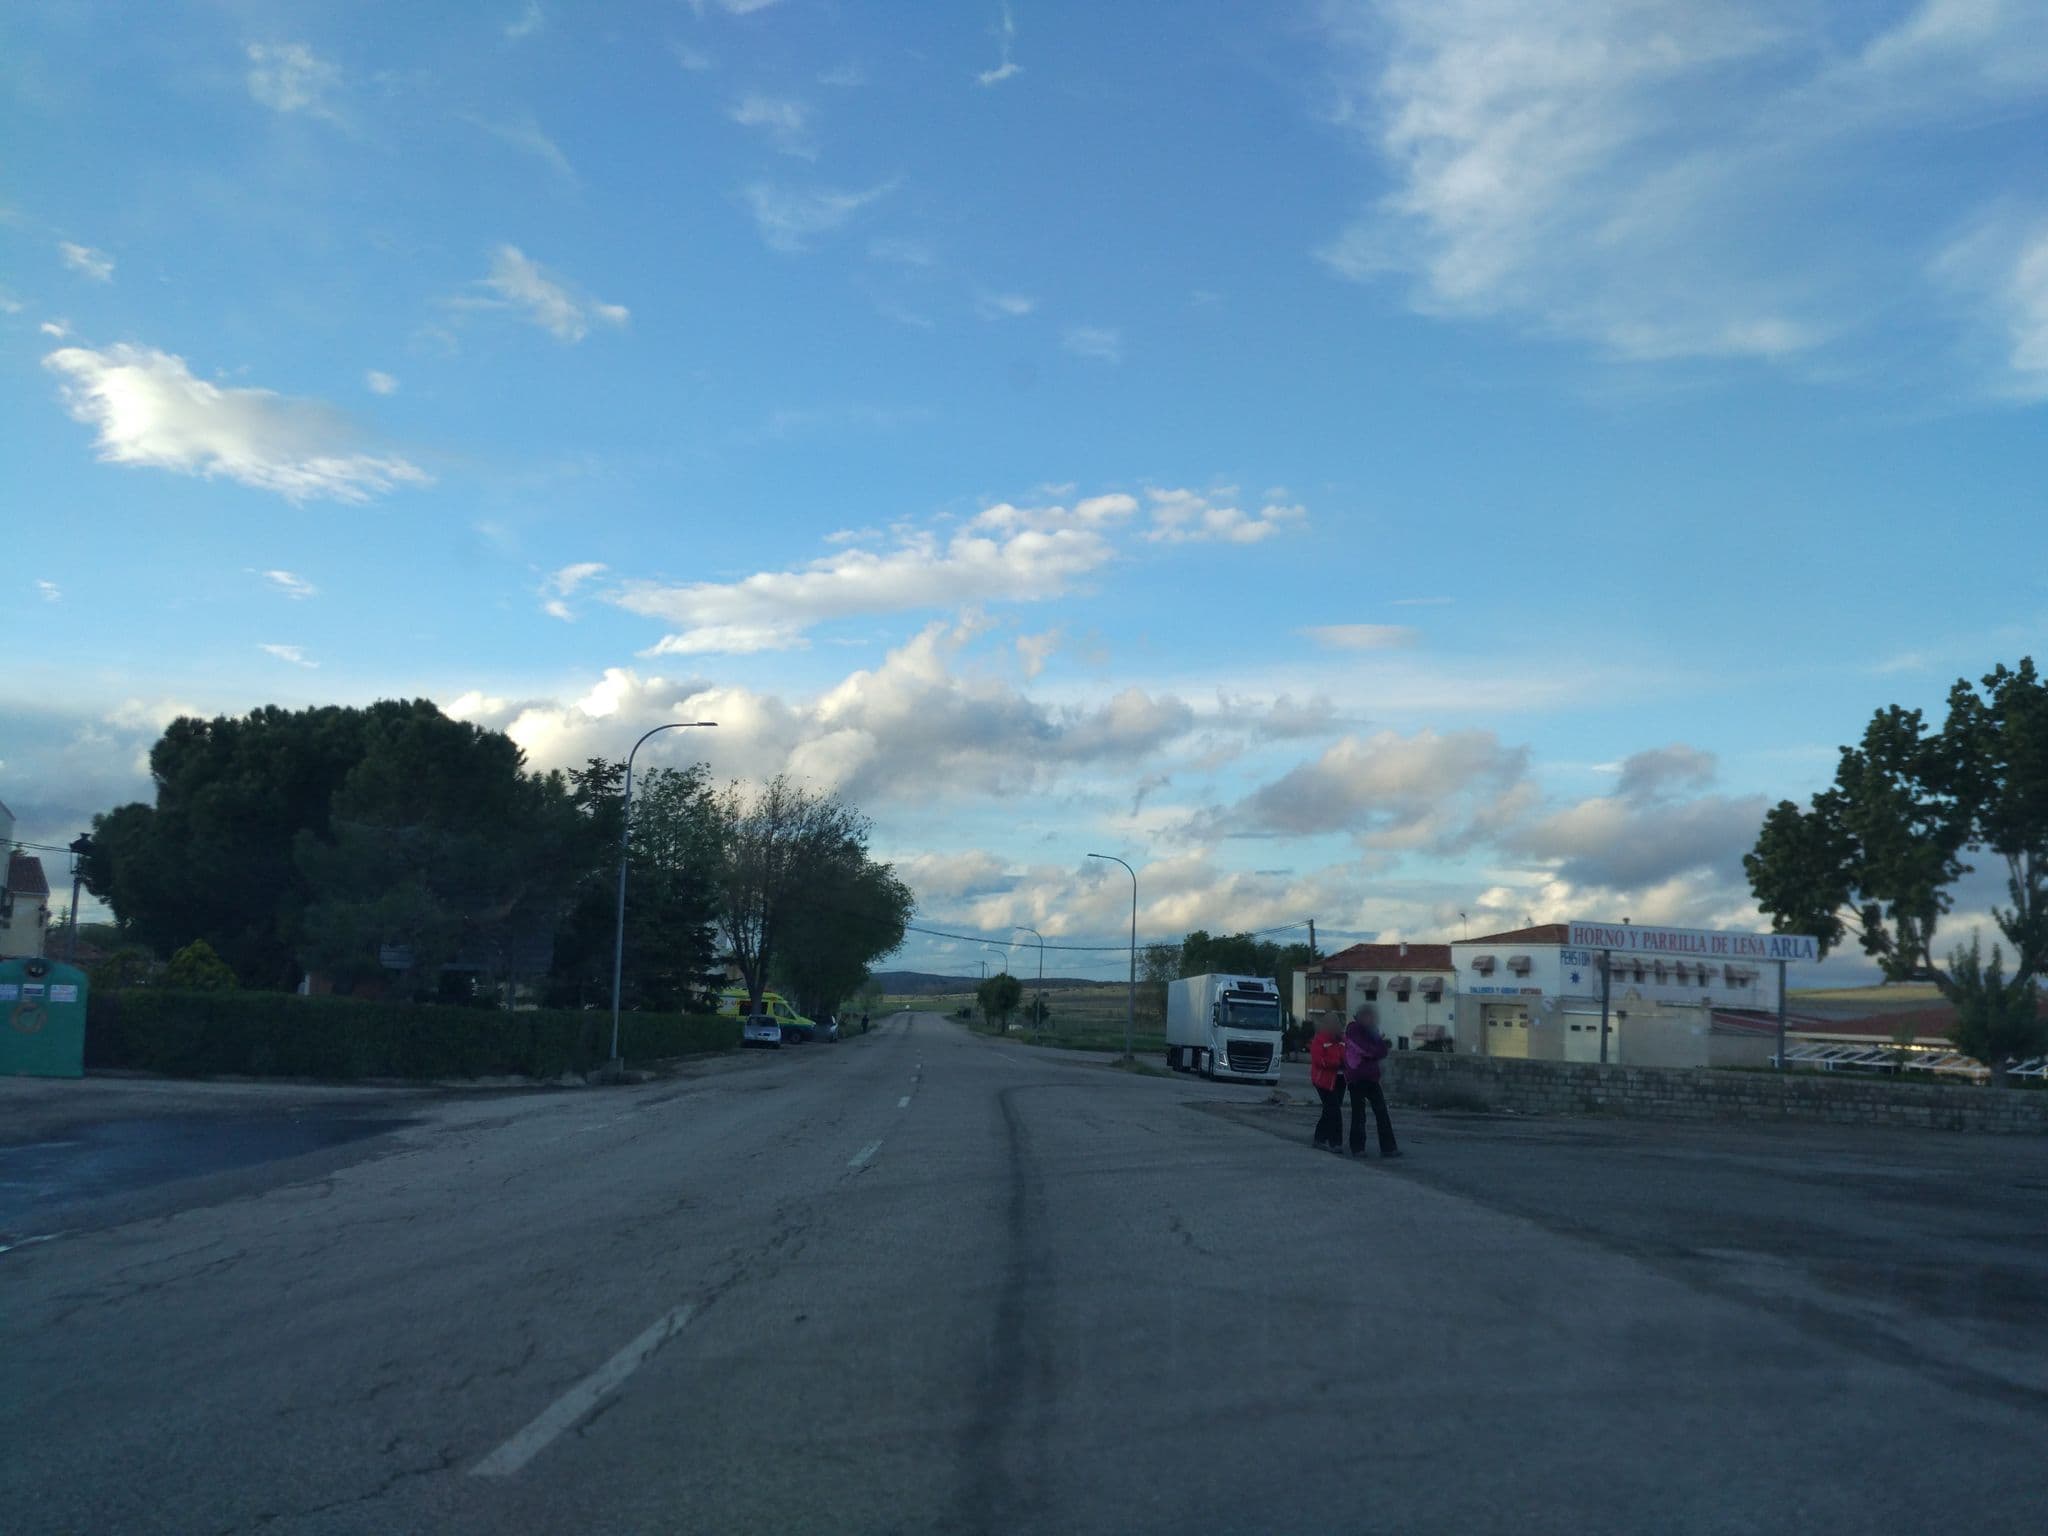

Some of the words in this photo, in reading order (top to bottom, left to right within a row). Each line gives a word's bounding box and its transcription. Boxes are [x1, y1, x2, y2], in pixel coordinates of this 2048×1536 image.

[1573, 927, 1625, 949] HORNO
[1628, 931, 1639, 949] Y
[1643, 931, 1707, 953] PARRILLA
[1711, 935, 1729, 953] DE
[1733, 934, 1767, 956] LEÑA
[1770, 936, 1814, 959] ARLA
